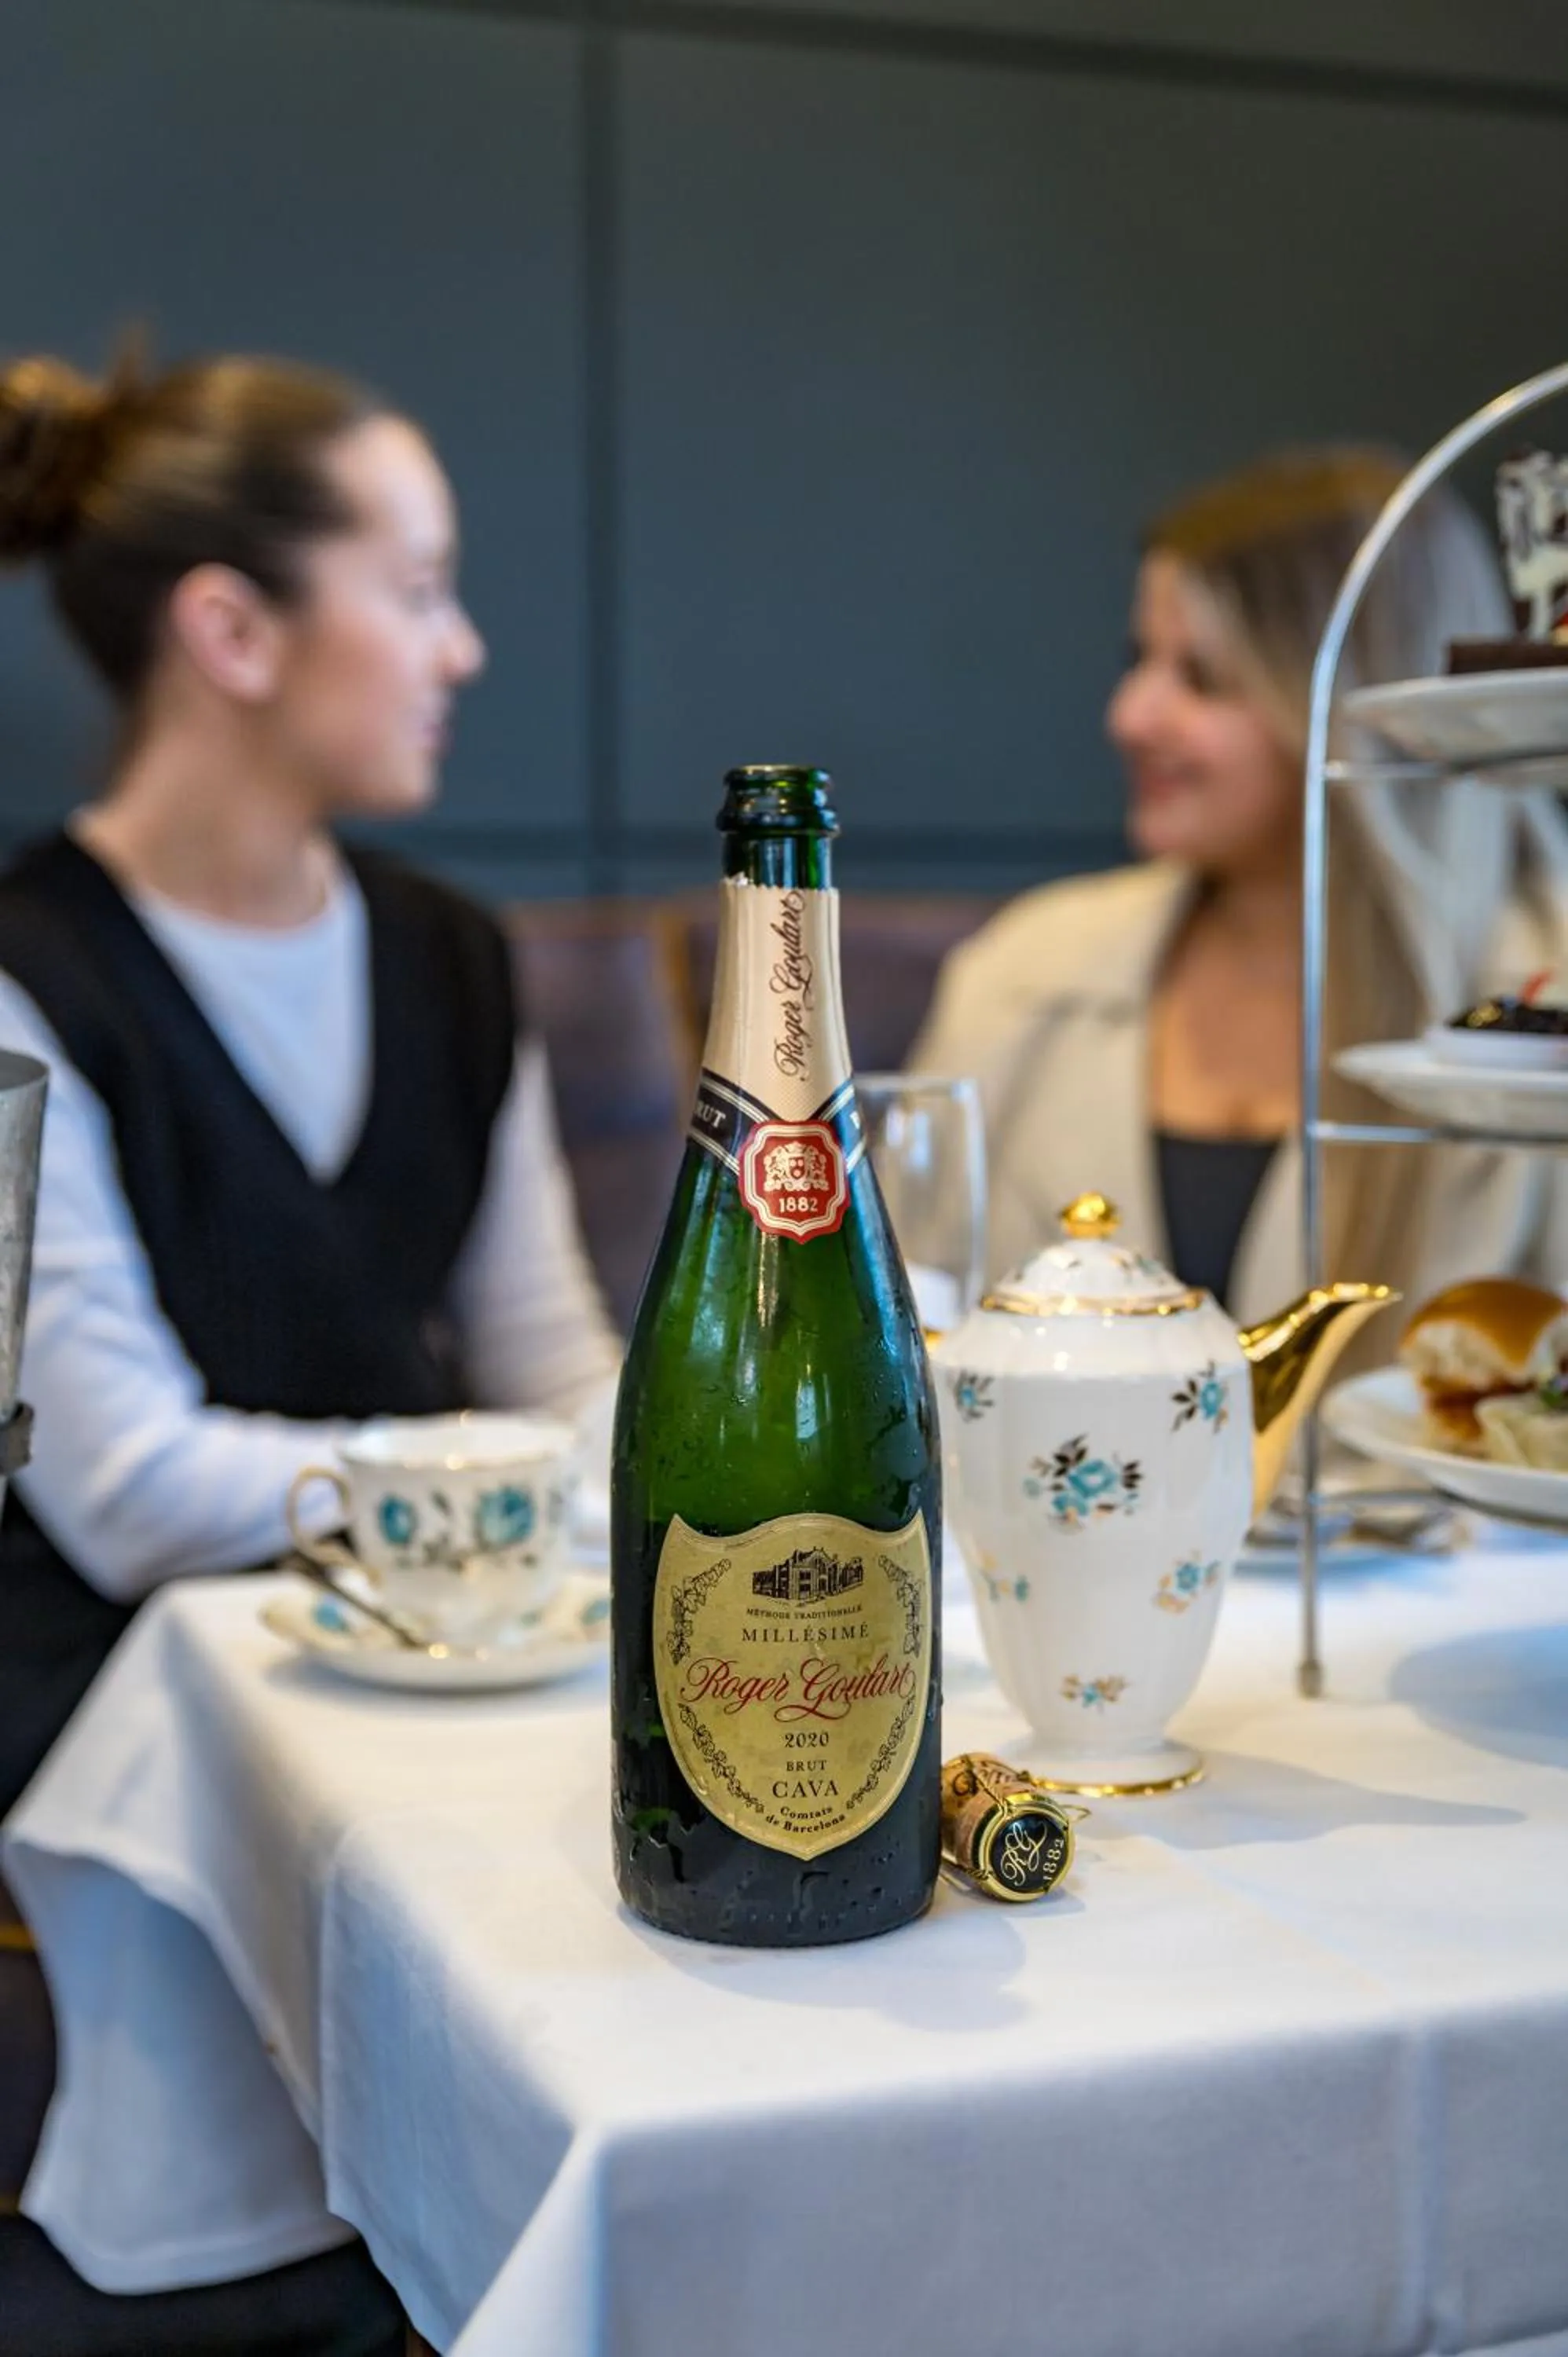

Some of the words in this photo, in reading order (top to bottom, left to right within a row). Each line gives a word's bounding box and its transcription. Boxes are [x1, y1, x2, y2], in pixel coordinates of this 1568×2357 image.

[769, 890, 814, 1011] Goulart
[773, 1000, 813, 1082] Roger
[779, 1196, 819, 1213] 1882
[742, 1622, 869, 1643] MILLÉSIMÉ
[680, 1657, 789, 1715] Roger
[774, 1653, 917, 1722] Goulart
[785, 1730, 830, 1748] 2020
[786, 1759, 827, 1772] BRUT
[772, 1780, 839, 1799] CAVA
[766, 1814, 779, 1825] de
[783, 1813, 845, 1833] Barcelona
[1042, 1838, 1064, 1882] 1882
